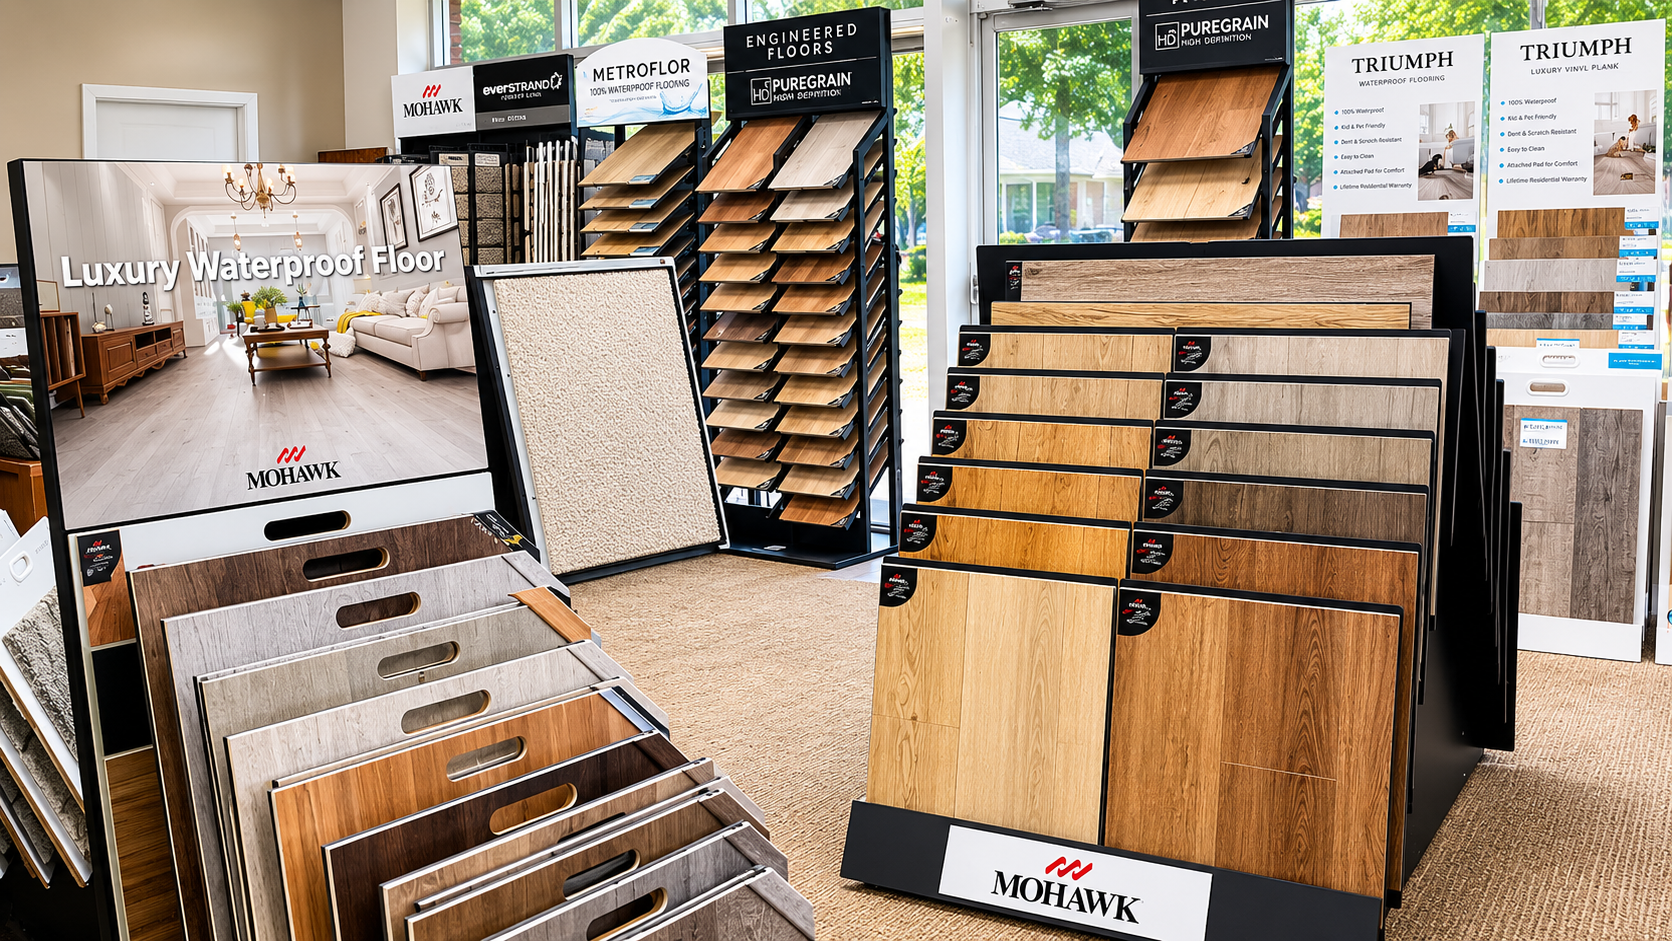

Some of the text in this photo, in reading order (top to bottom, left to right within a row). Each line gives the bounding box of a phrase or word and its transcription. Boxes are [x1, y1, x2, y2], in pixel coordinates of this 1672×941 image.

[746, 23, 857, 48] ENGINEERED
[1182, 15, 1268, 36] PUREGRAIN
[768, 41, 833, 60] FLOORS
[1520, 37, 1632, 61] TRIUMPH
[593, 58, 690, 82] METROFLOR
[1351, 51, 1454, 74] TRIUMPH
[483, 80, 550, 96] everSTRAND
[773, 72, 851, 92] PUREGRAIN
[1359, 77, 1406, 87] WATERPROOF
[403, 98, 463, 118] MOHAWK
[61, 244, 446, 291] Luxury Waterproof Floor
[246, 461, 341, 490] MOHAWK
[991, 870, 1141, 924] MOHAWK
